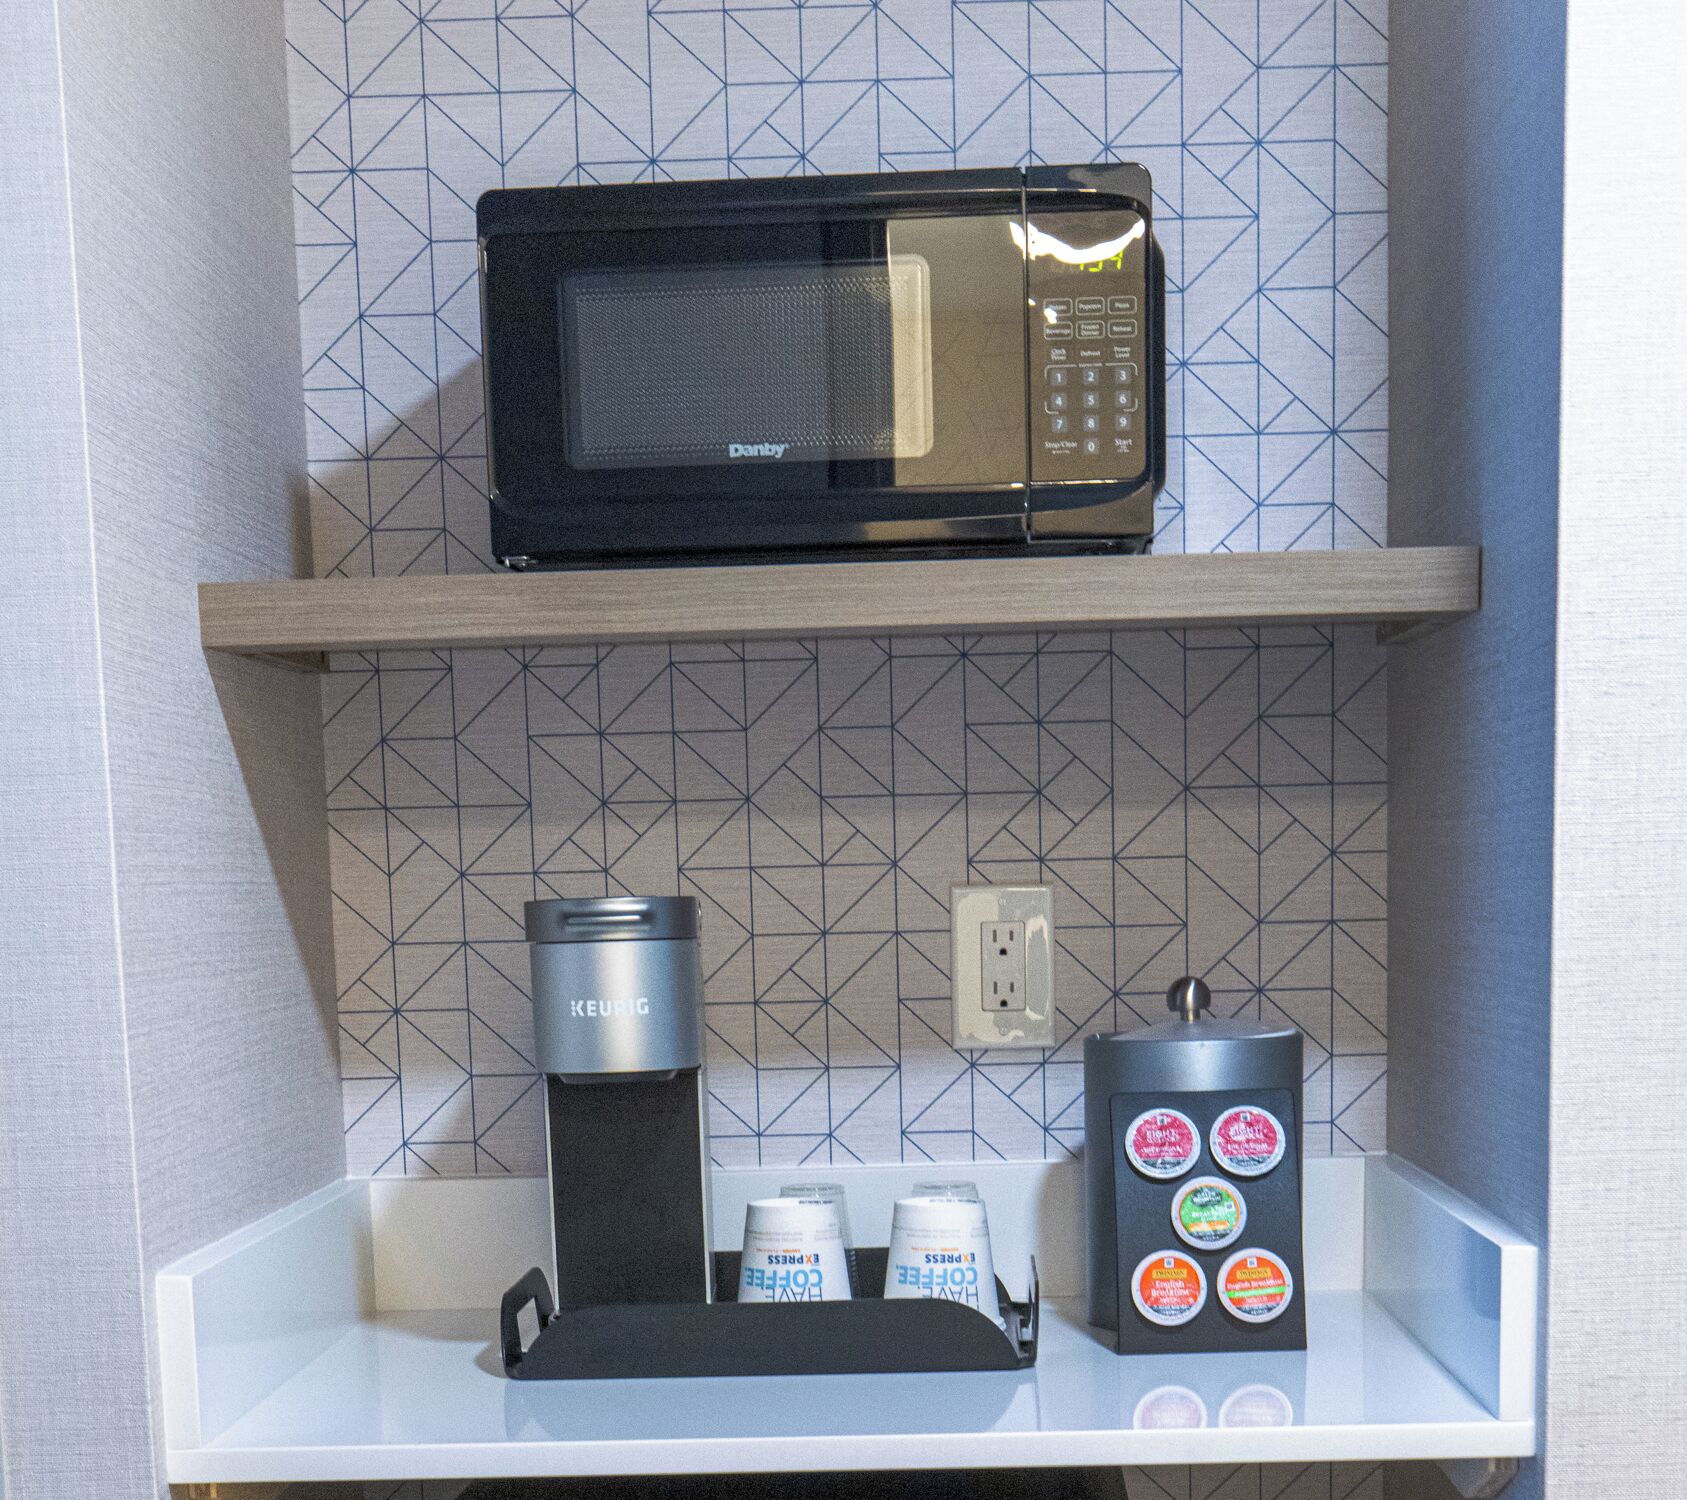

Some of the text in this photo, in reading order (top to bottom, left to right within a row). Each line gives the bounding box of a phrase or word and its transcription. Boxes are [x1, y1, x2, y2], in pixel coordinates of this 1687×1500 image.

[1055, 372, 1062, 383] 1
[1086, 371, 1095, 382] 2
[1119, 370, 1127, 381] 3
[1055, 395, 1063, 407] 4
[1087, 394, 1095, 406] 5
[1119, 393, 1127, 404] 6
[1056, 418, 1063, 429] 7
[1087, 417, 1095, 429] 8
[1119, 417, 1127, 428] 9
[728, 442, 786, 459] Danby
[1087, 441, 1095, 452] 0
[570, 997, 650, 1017] KEURIG
[767, 1252, 820, 1265] EXPRESS
[924, 1252, 976, 1264] EXPRESS
